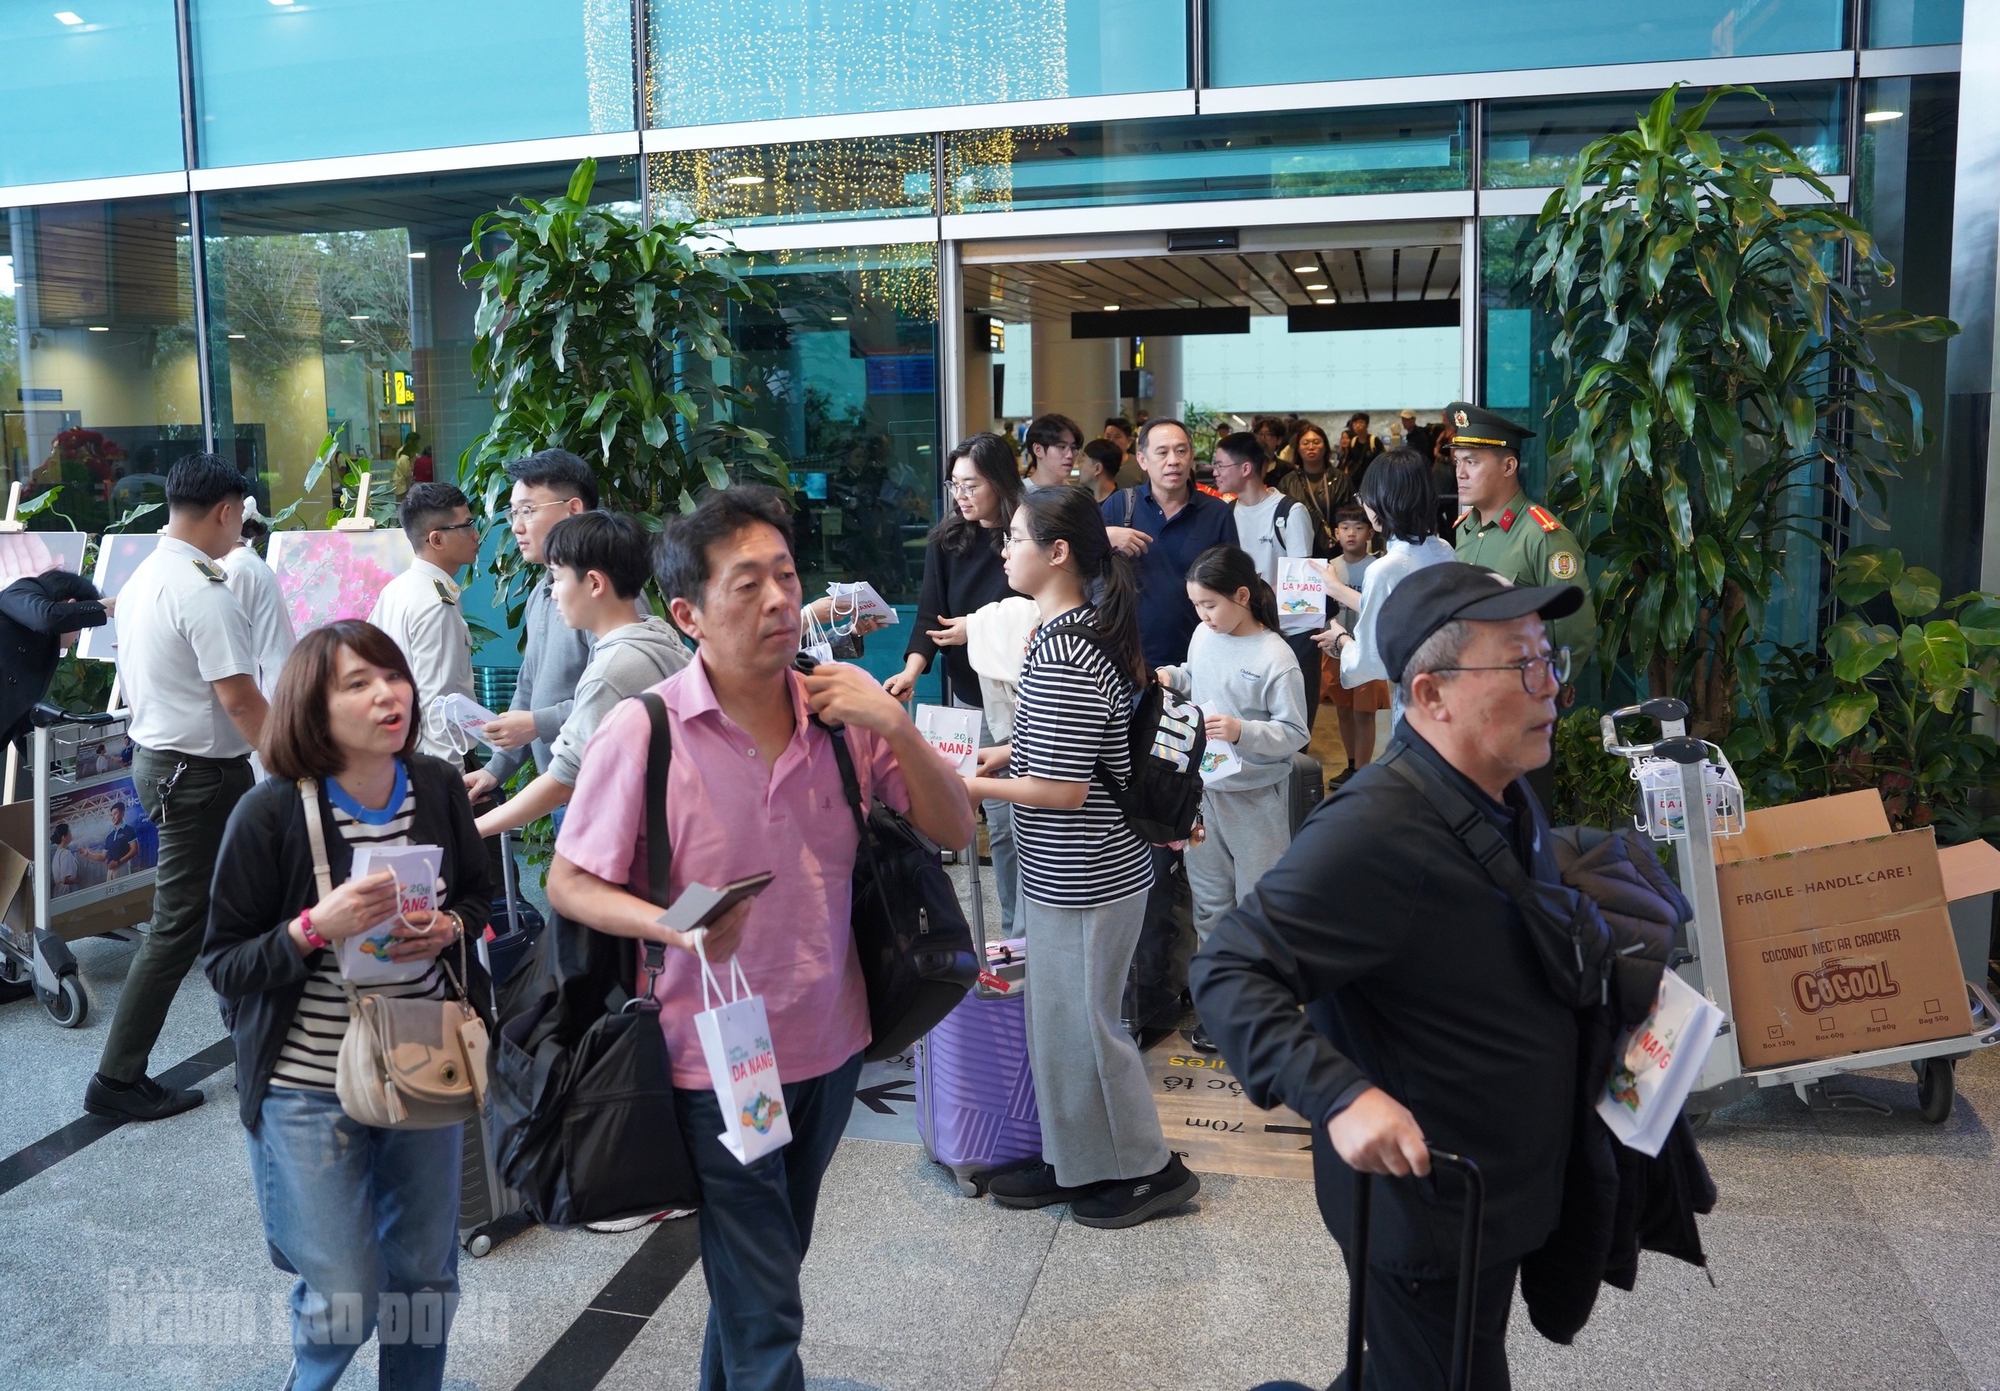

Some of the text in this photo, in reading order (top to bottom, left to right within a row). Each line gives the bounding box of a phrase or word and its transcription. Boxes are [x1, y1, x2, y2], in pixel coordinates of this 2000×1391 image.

[1297, 583, 1322, 592] NANG
[954, 732, 973, 744] 2026
[939, 741, 973, 755] NANG
[409, 883, 431, 896] 2026
[1736, 886, 1794, 906] FRAGILE
[1805, 874, 1864, 893] HANDLE
[1867, 867, 1905, 883] CARE
[400, 896, 429, 913] ANG
[1761, 928, 1901, 964] COCONUT NECTAR CRACKER
[1918, 1014, 1950, 1025] Bag 50g
[1867, 1023, 1897, 1034] Bag 80g
[1830, 1032, 1845, 1040] 60g
[1777, 1039, 1796, 1048] 120g
[732, 1062, 748, 1083] DA
[748, 1051, 774, 1077] NANG
[1185, 1117, 1246, 1133] 70m
